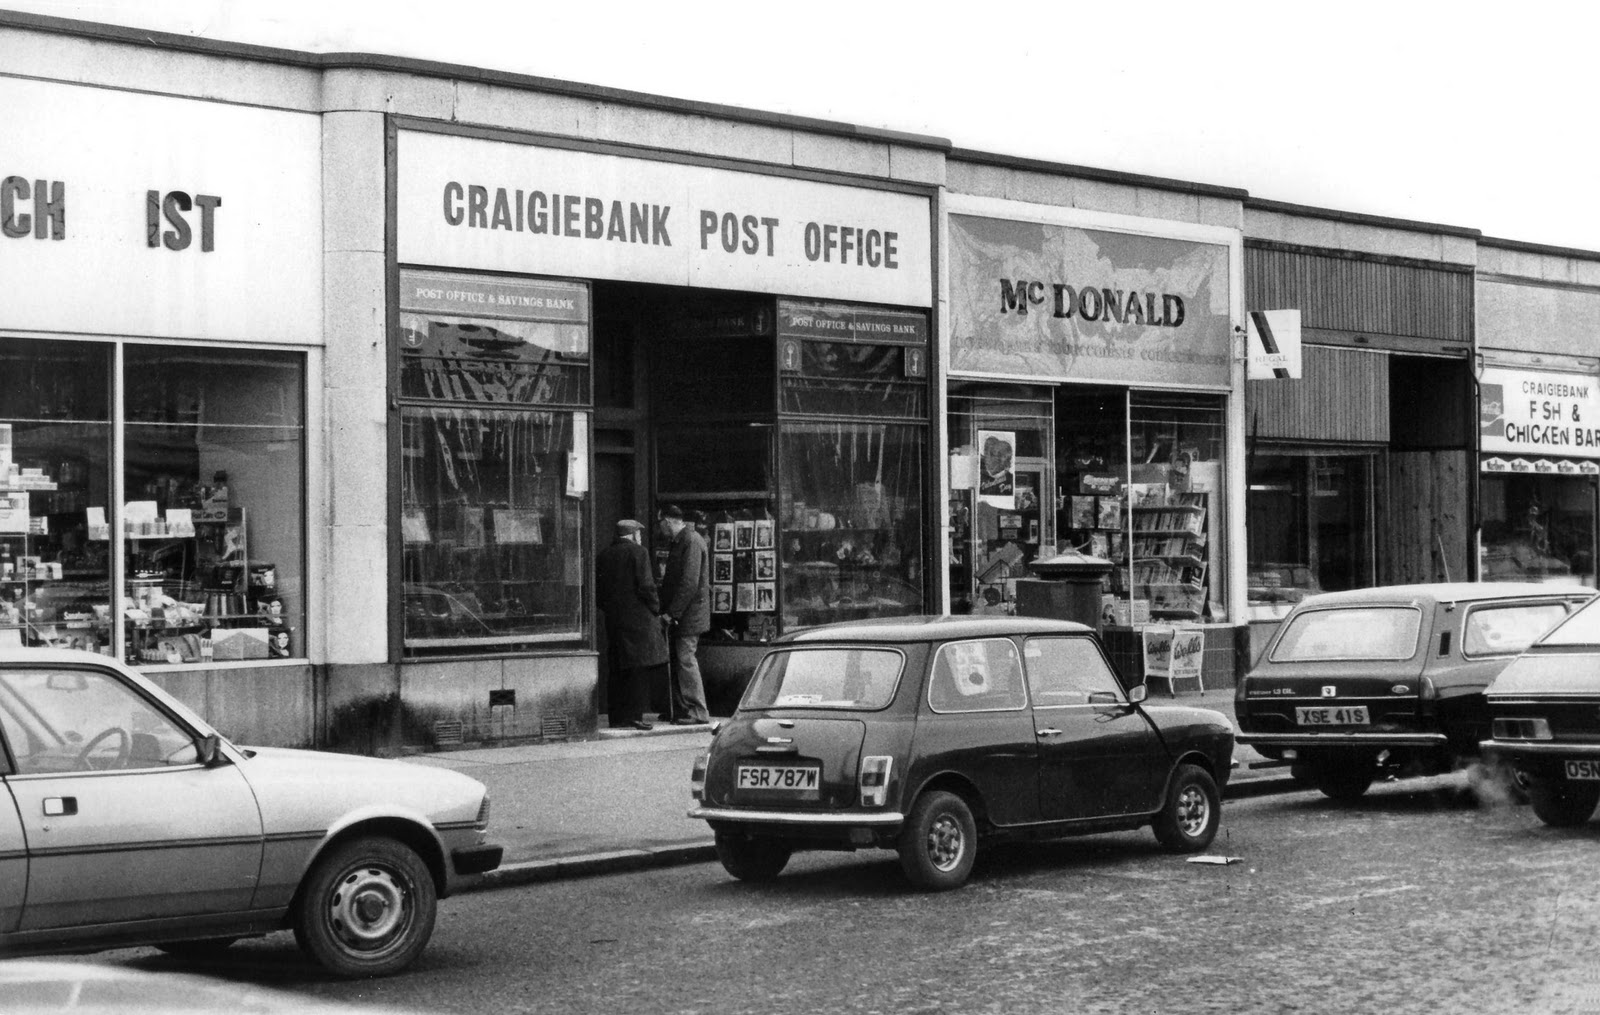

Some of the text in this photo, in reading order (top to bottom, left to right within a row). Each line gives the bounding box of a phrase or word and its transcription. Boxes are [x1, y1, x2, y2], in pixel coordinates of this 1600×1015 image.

[442, 180, 900, 270] CRAIGIEBANK POST OFFICE
[416, 287, 574, 310] POST OFFICE & SAVINGS BANK
[791, 316, 814, 328] POST
[815, 319, 846, 331] OFFICE
[855, 322, 891, 333] SAVINGS
[893, 324, 916, 335] BANK
[1522, 381, 1589, 399] CRAIGIEBANK
[1571, 403, 1580, 422] &
[1505, 422, 1600, 447] CHICKEN BAR
[1302, 709, 1364, 724] XSE 41S
[740, 768, 817, 787] FSR 787W
